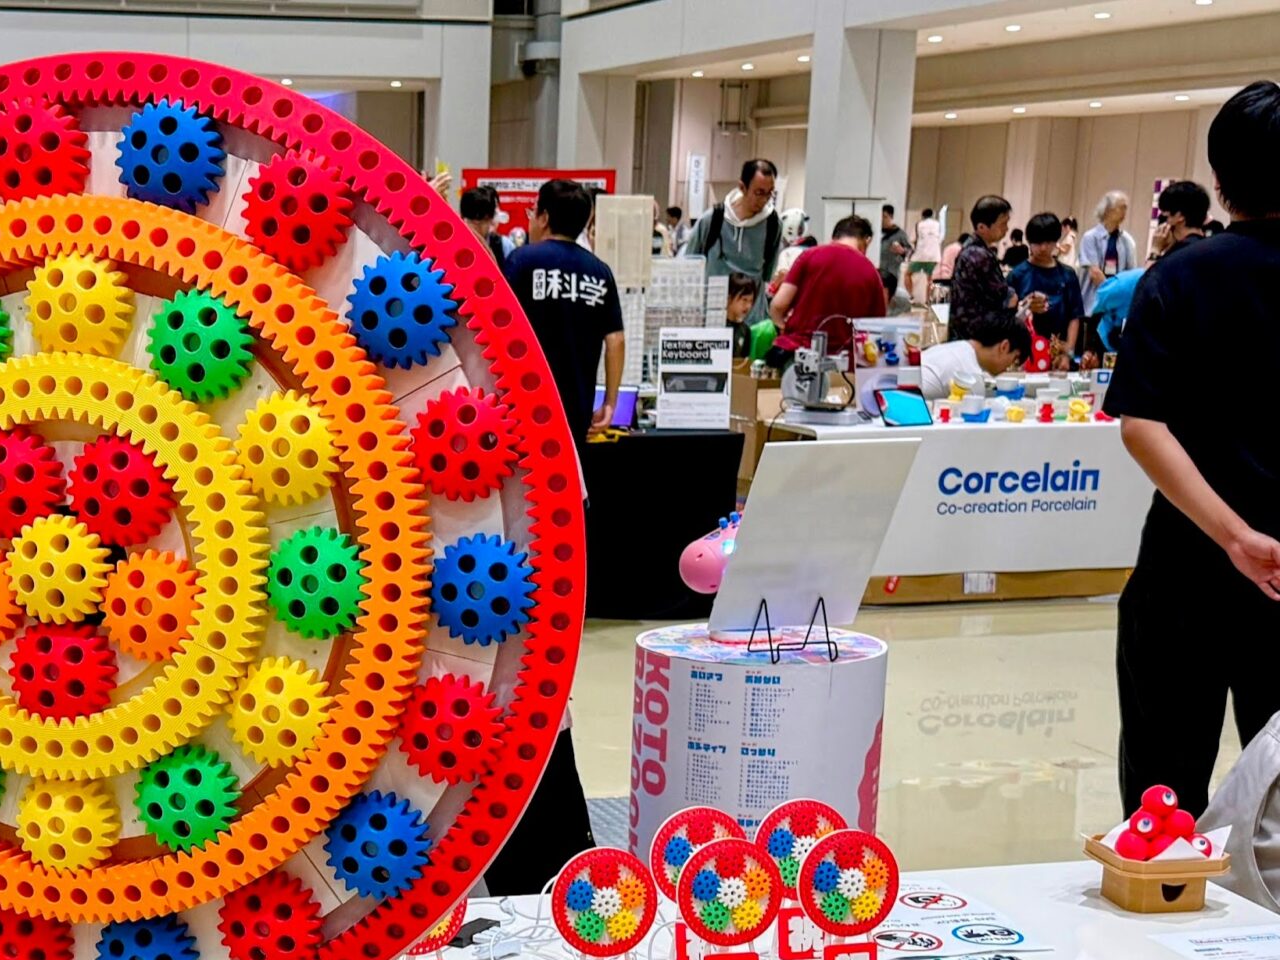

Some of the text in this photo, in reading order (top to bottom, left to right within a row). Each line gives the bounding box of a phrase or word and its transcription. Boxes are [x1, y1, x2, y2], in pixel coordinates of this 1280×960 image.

[546, 268, 608, 307] 科学
[662, 350, 709, 359] Keyboard
[663, 341, 728, 350] Textile Circuit
[938, 459, 1100, 496] Corcelain
[936, 496, 1097, 515] Co-creation Porcelain
[640, 650, 671, 798] KOTO
